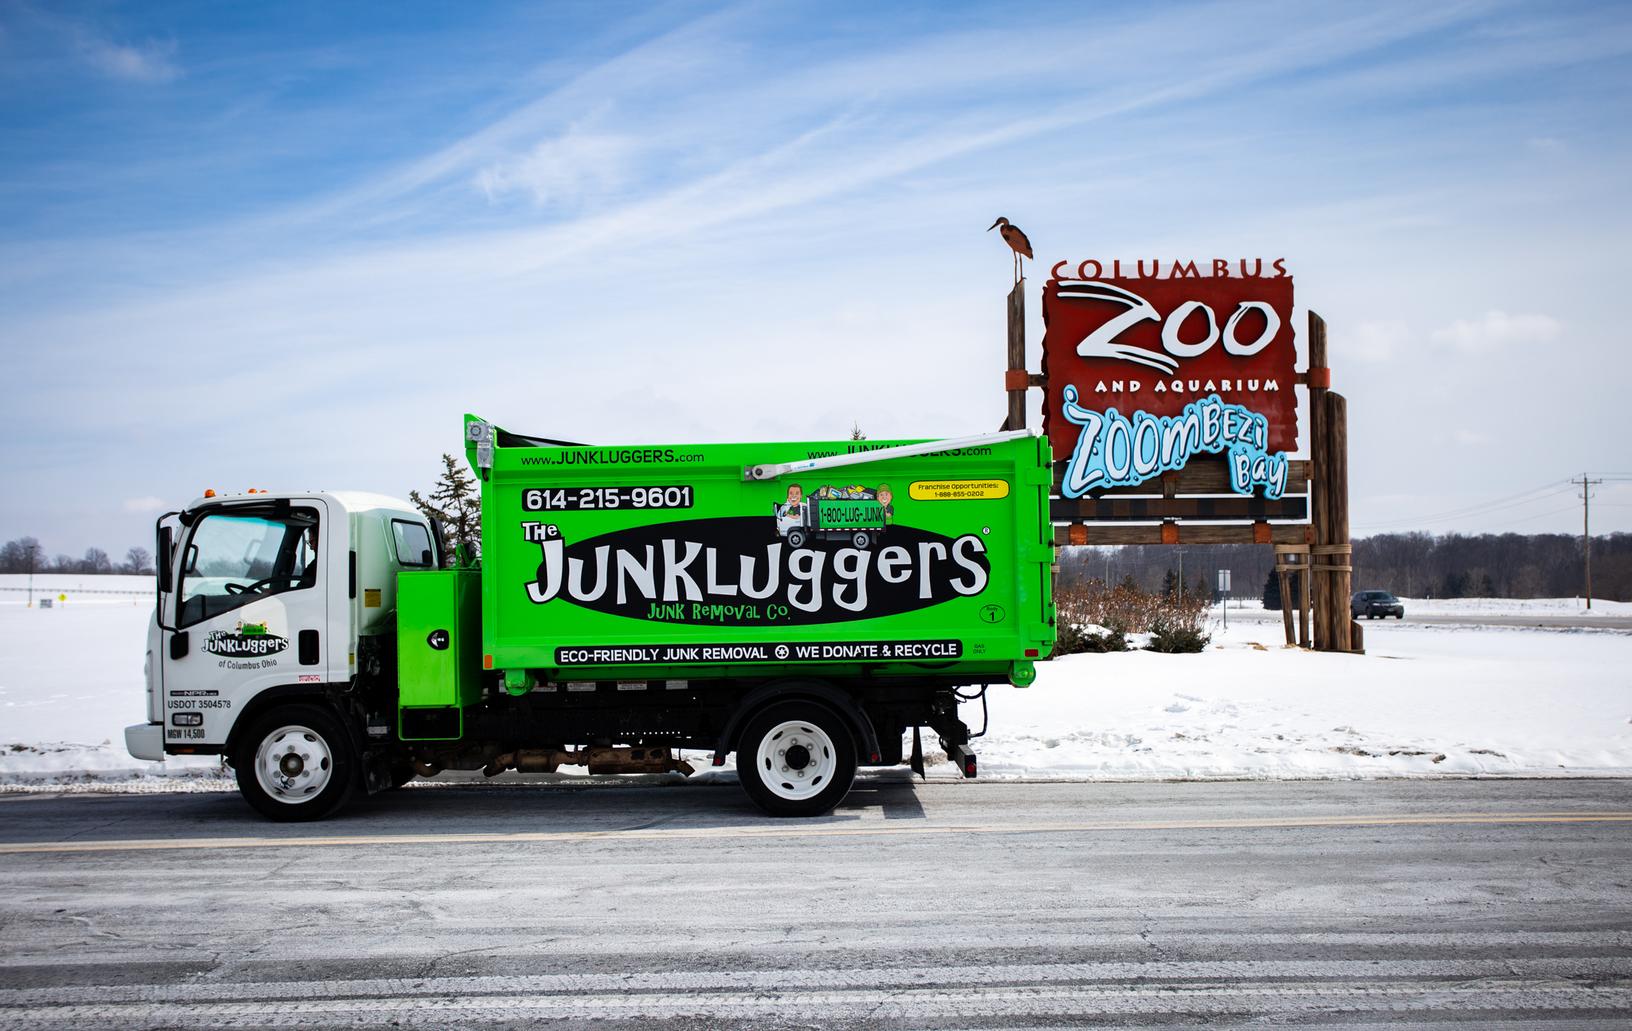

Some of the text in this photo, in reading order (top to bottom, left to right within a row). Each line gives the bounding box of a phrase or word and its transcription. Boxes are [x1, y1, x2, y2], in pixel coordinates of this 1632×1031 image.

[1050, 258, 1287, 280] COLUMBUS
[1094, 379, 1280, 393] AND AQUARIUM
[520, 449, 705, 465] www.JUNKLUGGERS.com
[951, 482, 999, 491] Opportunities:
[526, 486, 690, 510] 614-215-9601
[820, 506, 884, 523] 1-800-LUG-JUNK
[989, 611, 995, 621] 1
[560, 643, 958, 663] ECO-FRIENDLY JUNK REMOVAL WE DONATE & RECYCLE
[218, 658, 278, 670] of Columbus Ohio
[167, 700, 232, 709] USDOT 3504578
